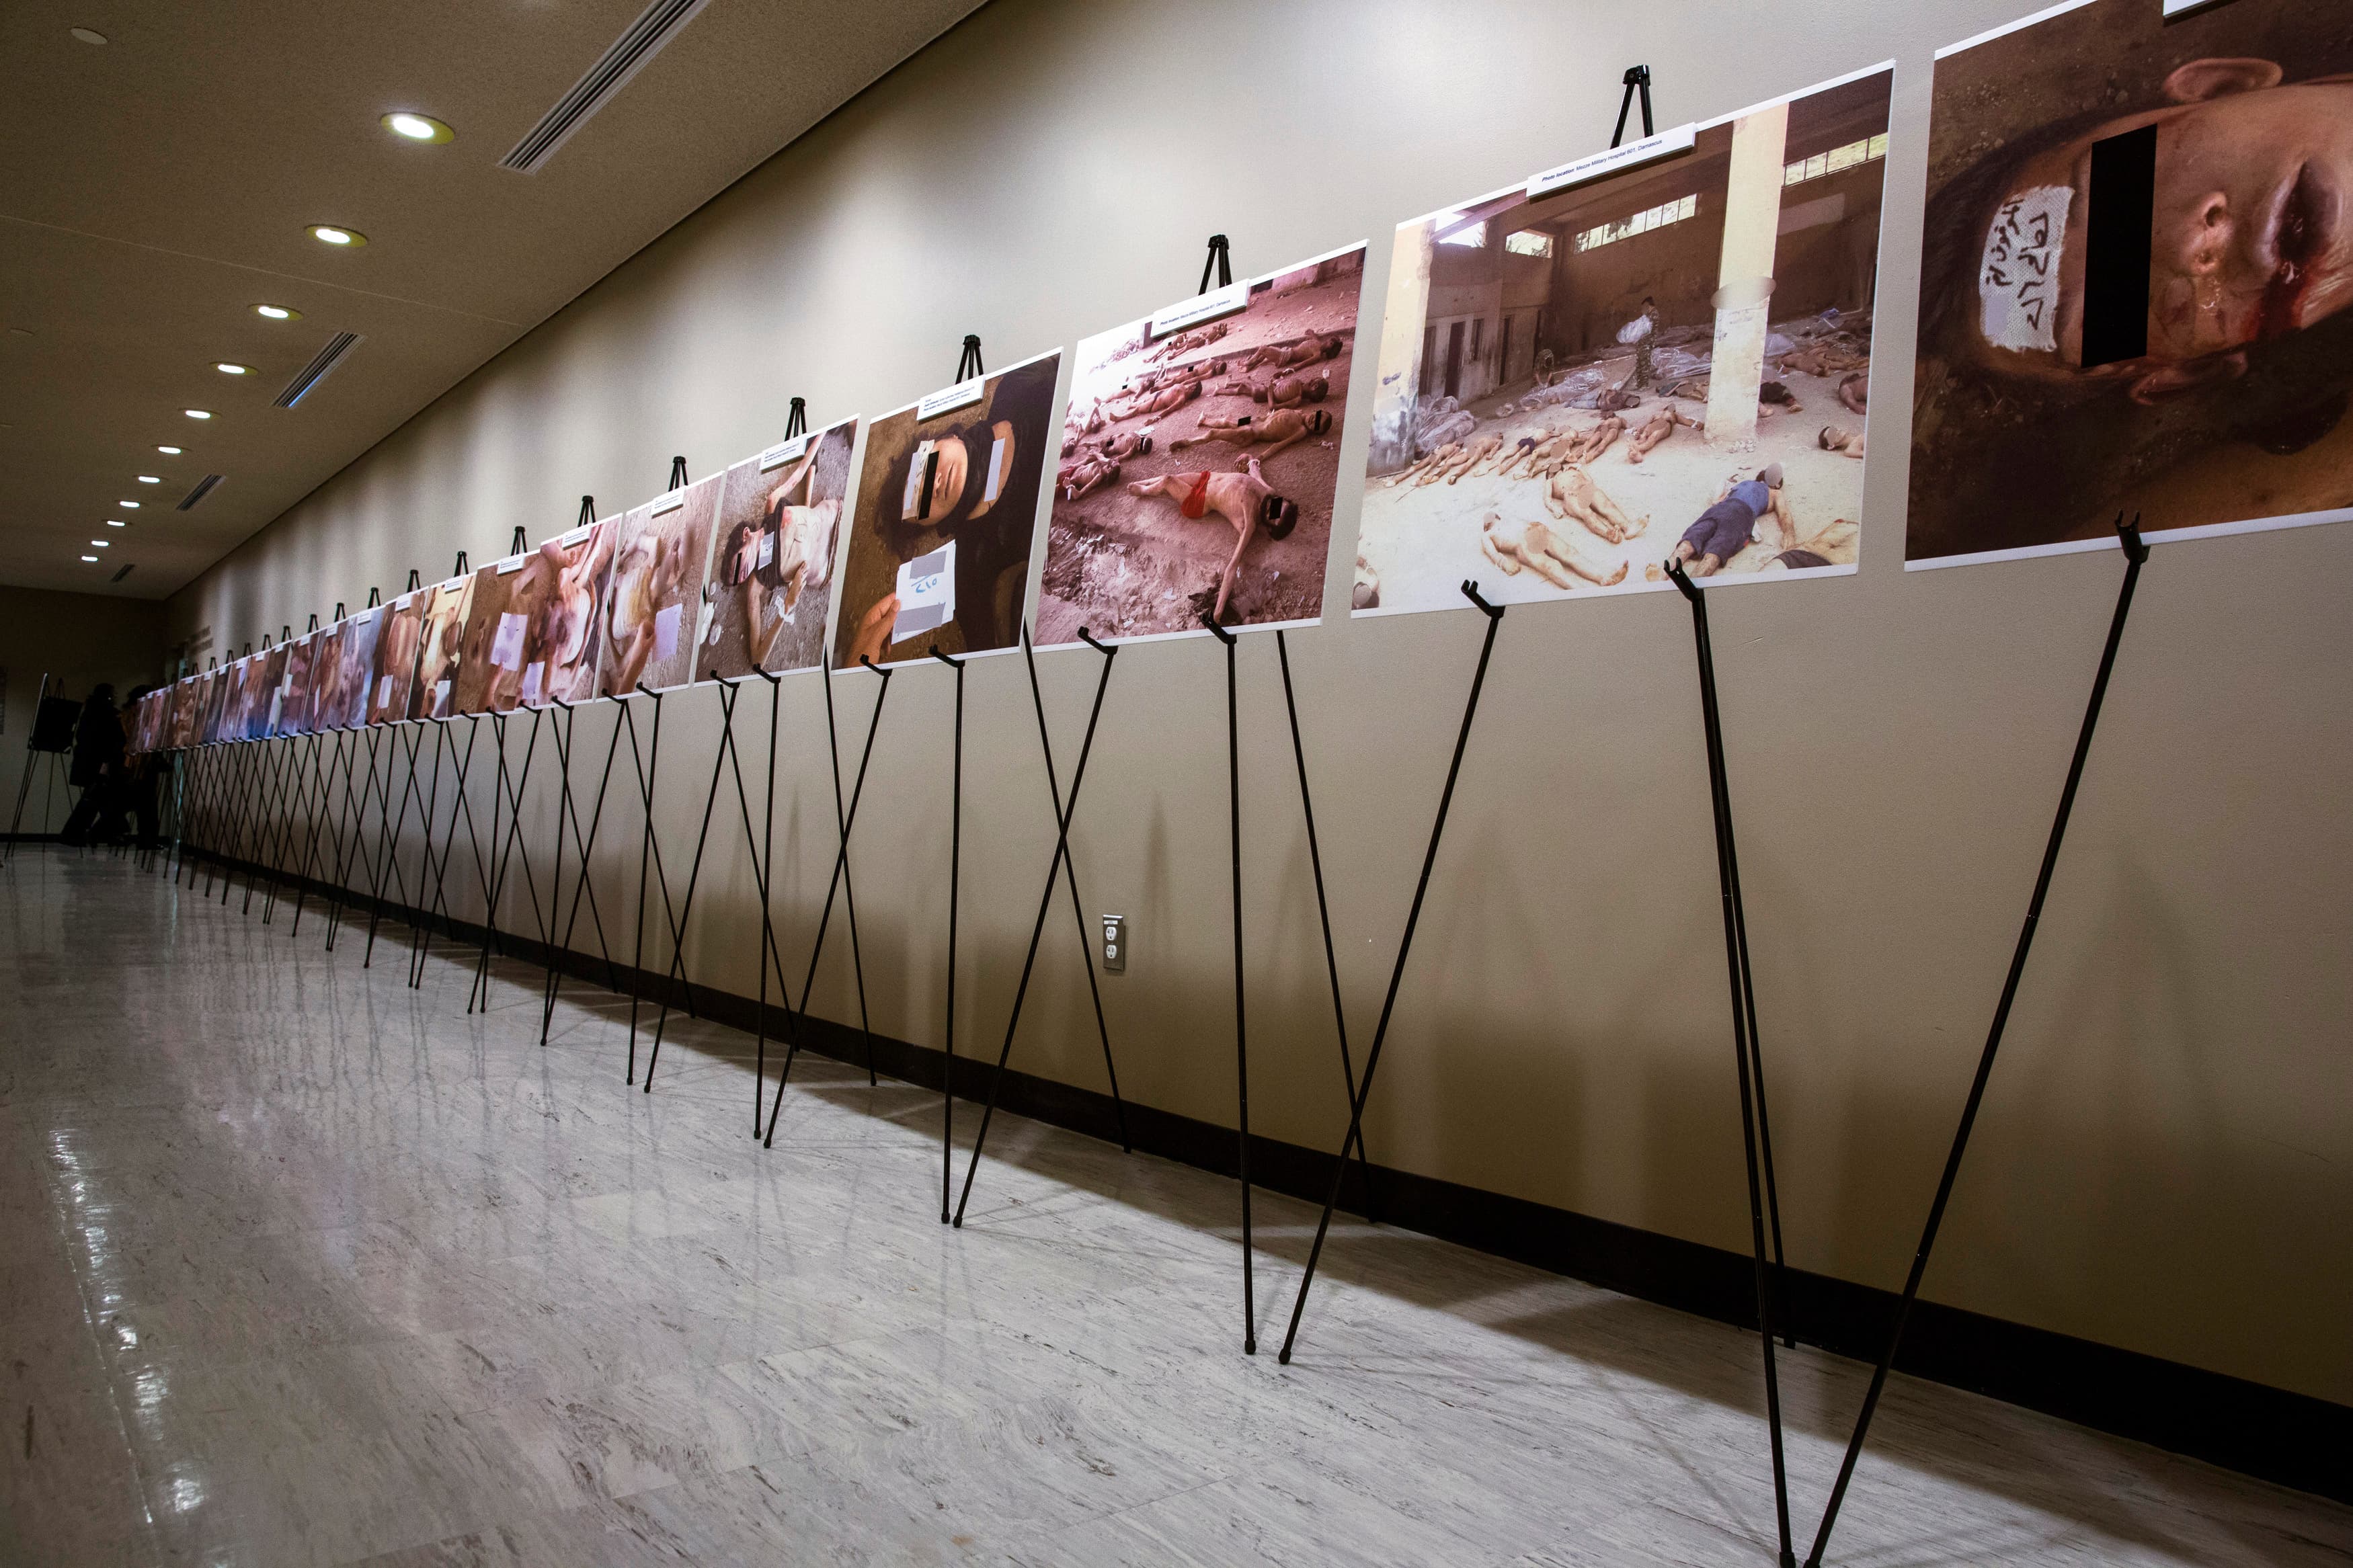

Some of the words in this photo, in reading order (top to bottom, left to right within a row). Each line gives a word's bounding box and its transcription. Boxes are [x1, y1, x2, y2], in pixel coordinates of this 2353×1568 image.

[1591, 158, 1607, 166] Military
[1607, 151, 1626, 160] Hospital
[1638, 140, 1663, 151] Damascus
